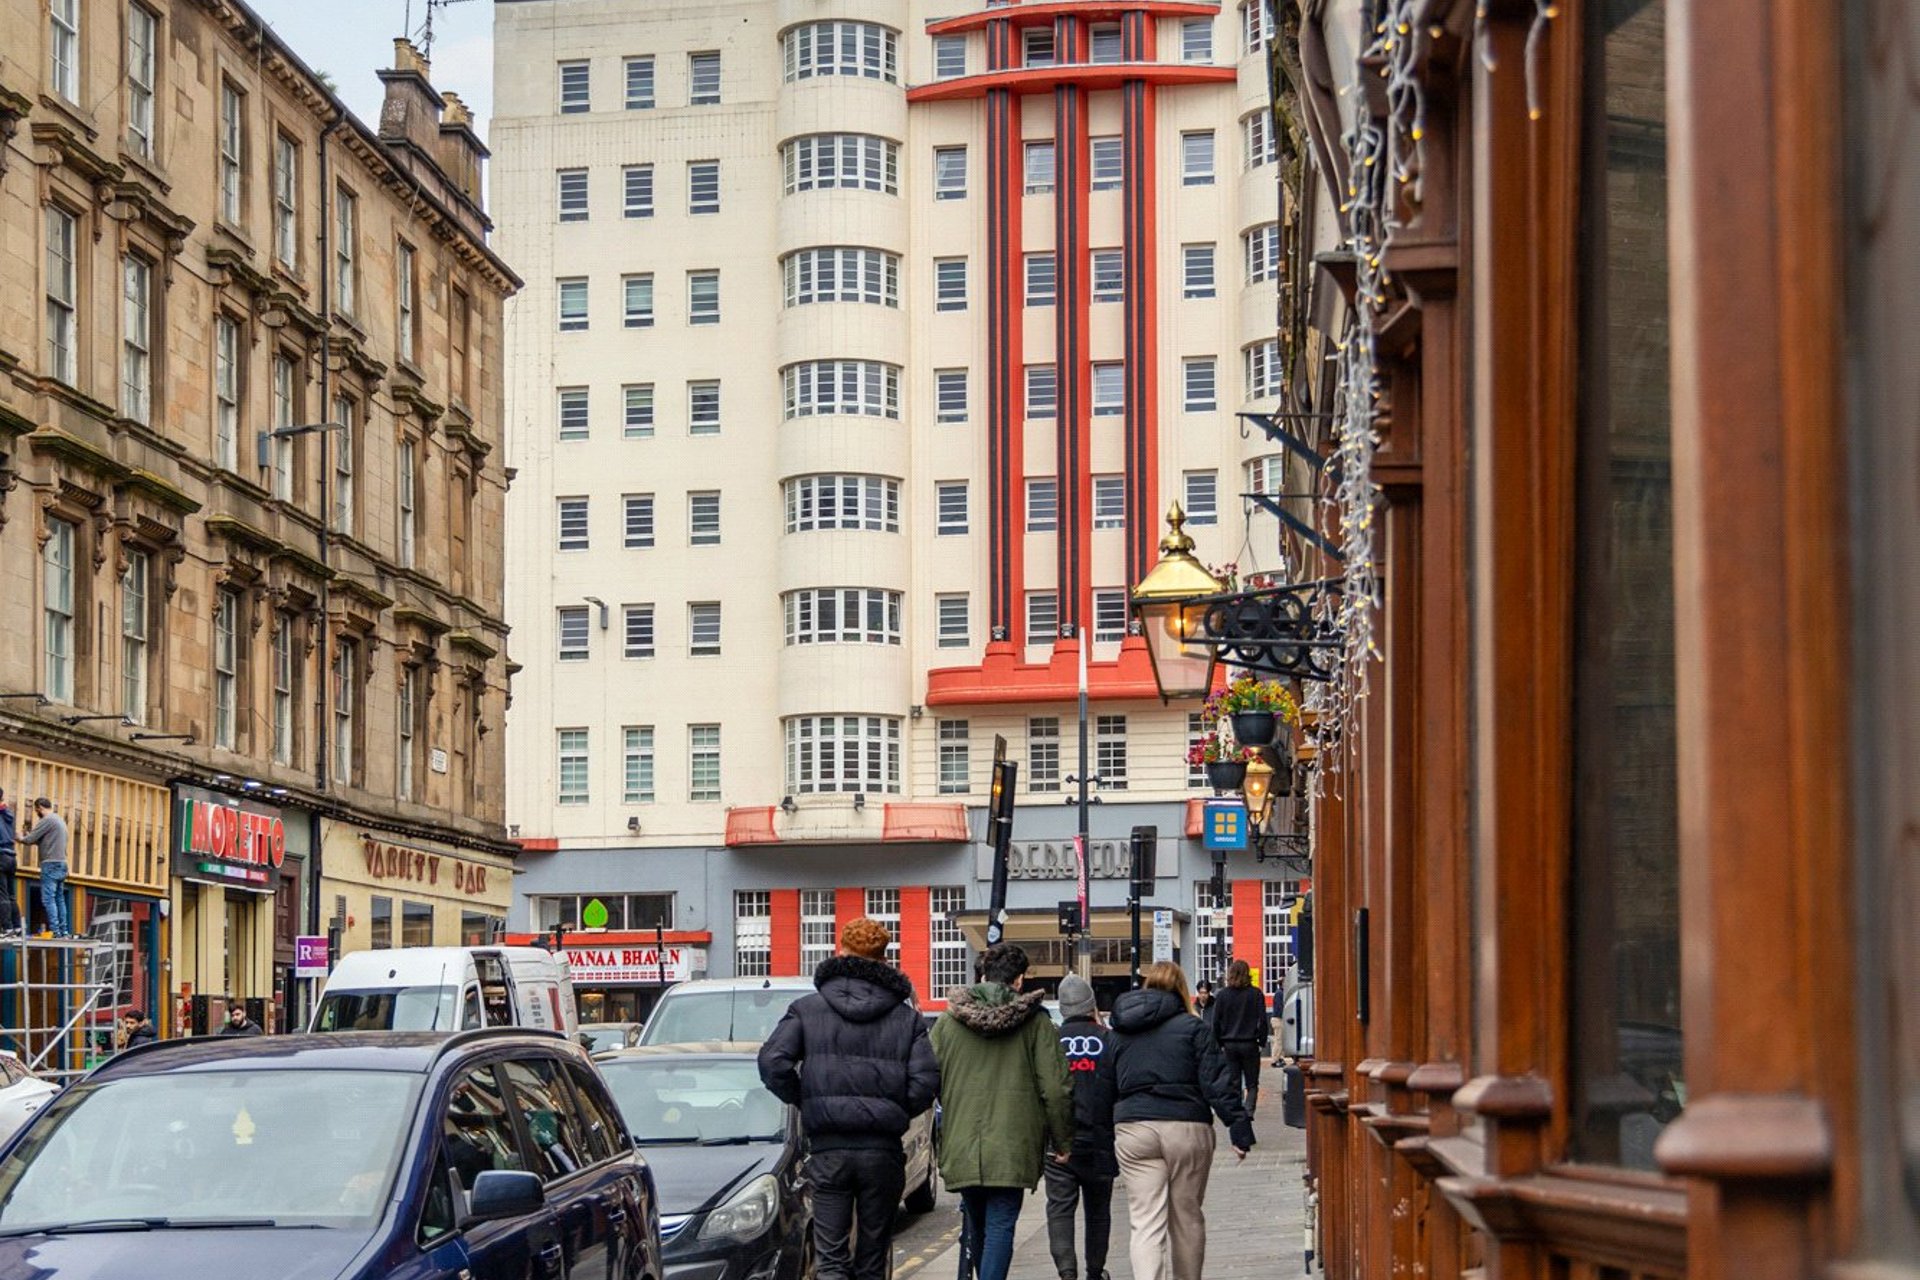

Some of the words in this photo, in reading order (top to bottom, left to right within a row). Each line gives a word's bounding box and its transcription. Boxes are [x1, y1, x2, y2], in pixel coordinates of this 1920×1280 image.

[188, 799, 286, 869] MORETTO
[364, 839, 440, 885] VARIETY
[454, 861, 487, 894] BAR
[299, 944, 312, 961] R
[567, 950, 617, 967] VANAA
[622, 949, 681, 966] BHAVN
